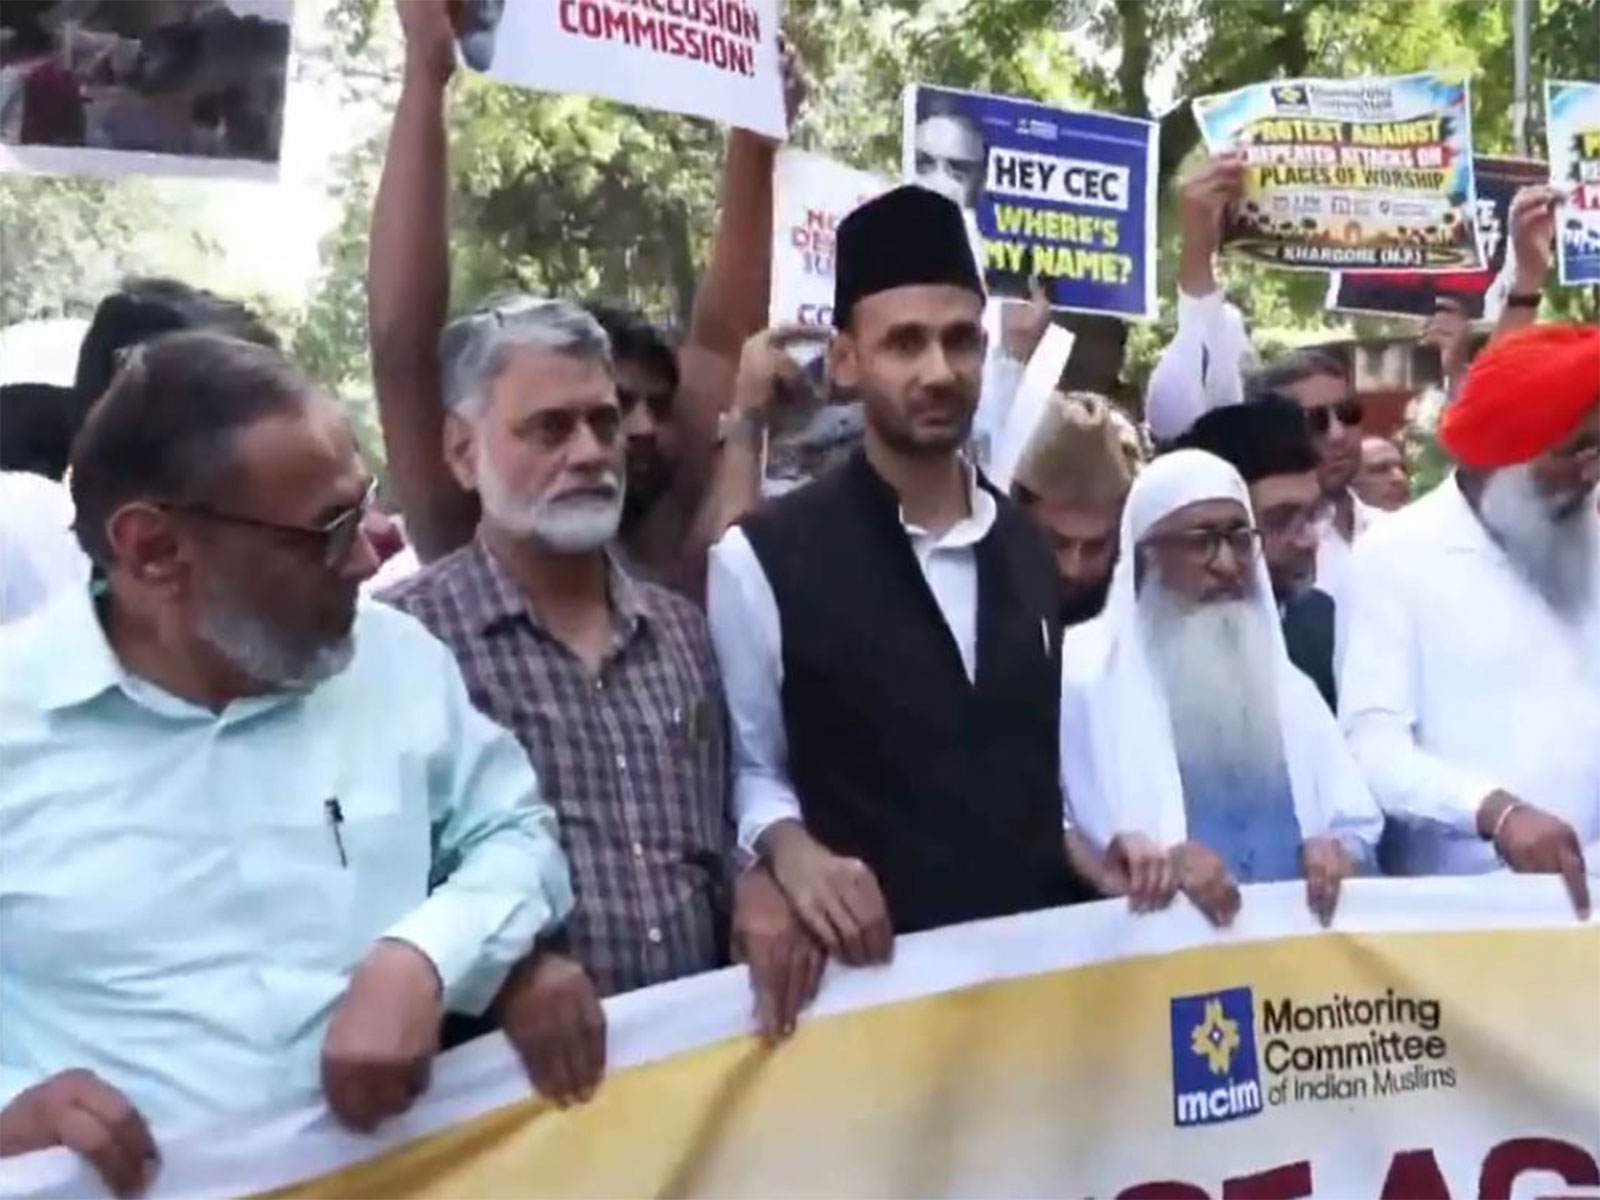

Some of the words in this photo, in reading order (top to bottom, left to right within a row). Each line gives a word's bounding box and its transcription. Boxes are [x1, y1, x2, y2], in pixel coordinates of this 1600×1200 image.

[559, 0, 756, 77] COMMISSION!
[613, 0, 761, 43] LUSION
[1352, 117, 1442, 147] AGAINST
[994, 155, 1056, 192] HEY
[1063, 167, 1120, 202] CEC
[1260, 166, 1331, 188] PLACES
[1335, 165, 1356, 183] OF
[1363, 170, 1445, 190] WORSHIP
[994, 203, 1119, 248] WHERE'S
[983, 239, 1025, 273] MY
[1032, 244, 1133, 284] NAME?
[1262, 988, 1441, 1031] Monitoring
[1264, 1030, 1447, 1076] Committee
[1176, 1078, 1260, 1122] mcim
[1268, 1077, 1290, 1106] of
[1294, 1073, 1367, 1102] Indian
[1372, 1064, 1457, 1097] Muslims
